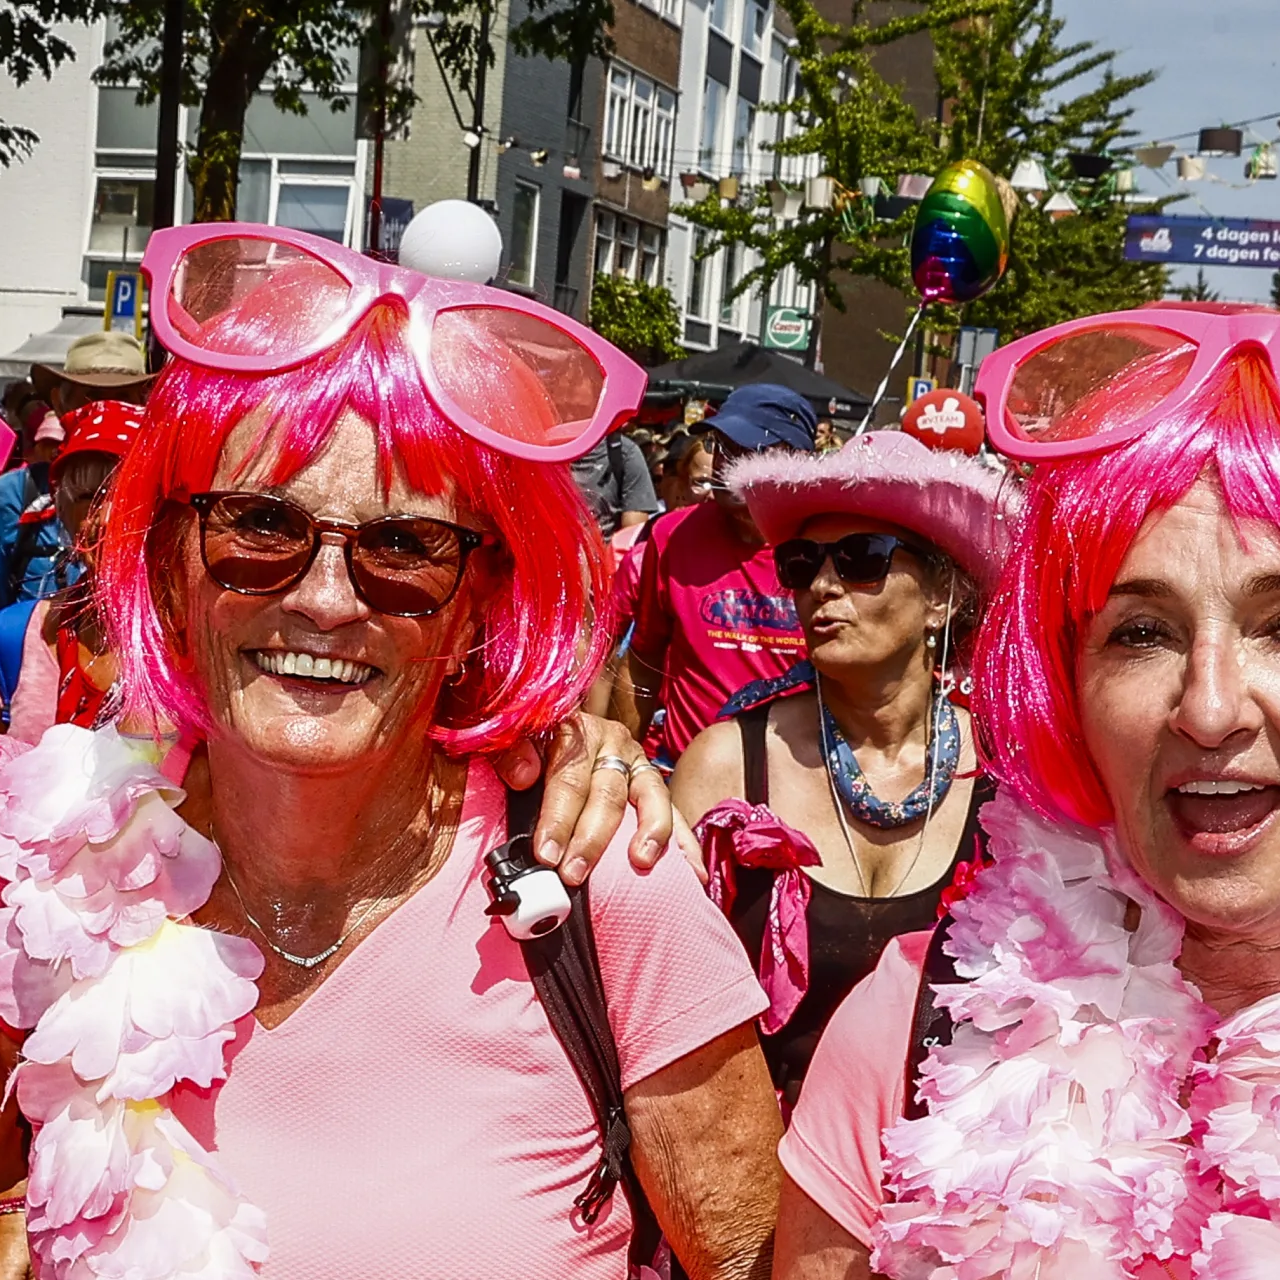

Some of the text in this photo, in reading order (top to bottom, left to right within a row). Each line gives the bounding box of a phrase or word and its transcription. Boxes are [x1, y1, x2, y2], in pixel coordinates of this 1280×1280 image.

[1201, 227, 1214, 241] 4
[1216, 227, 1270, 246] dagen
[1193, 243, 1205, 259] 7
[1205, 244, 1260, 263] dagen
[117, 281, 132, 314] P
[707, 629, 807, 646] THE WALK OF THE WORLD
